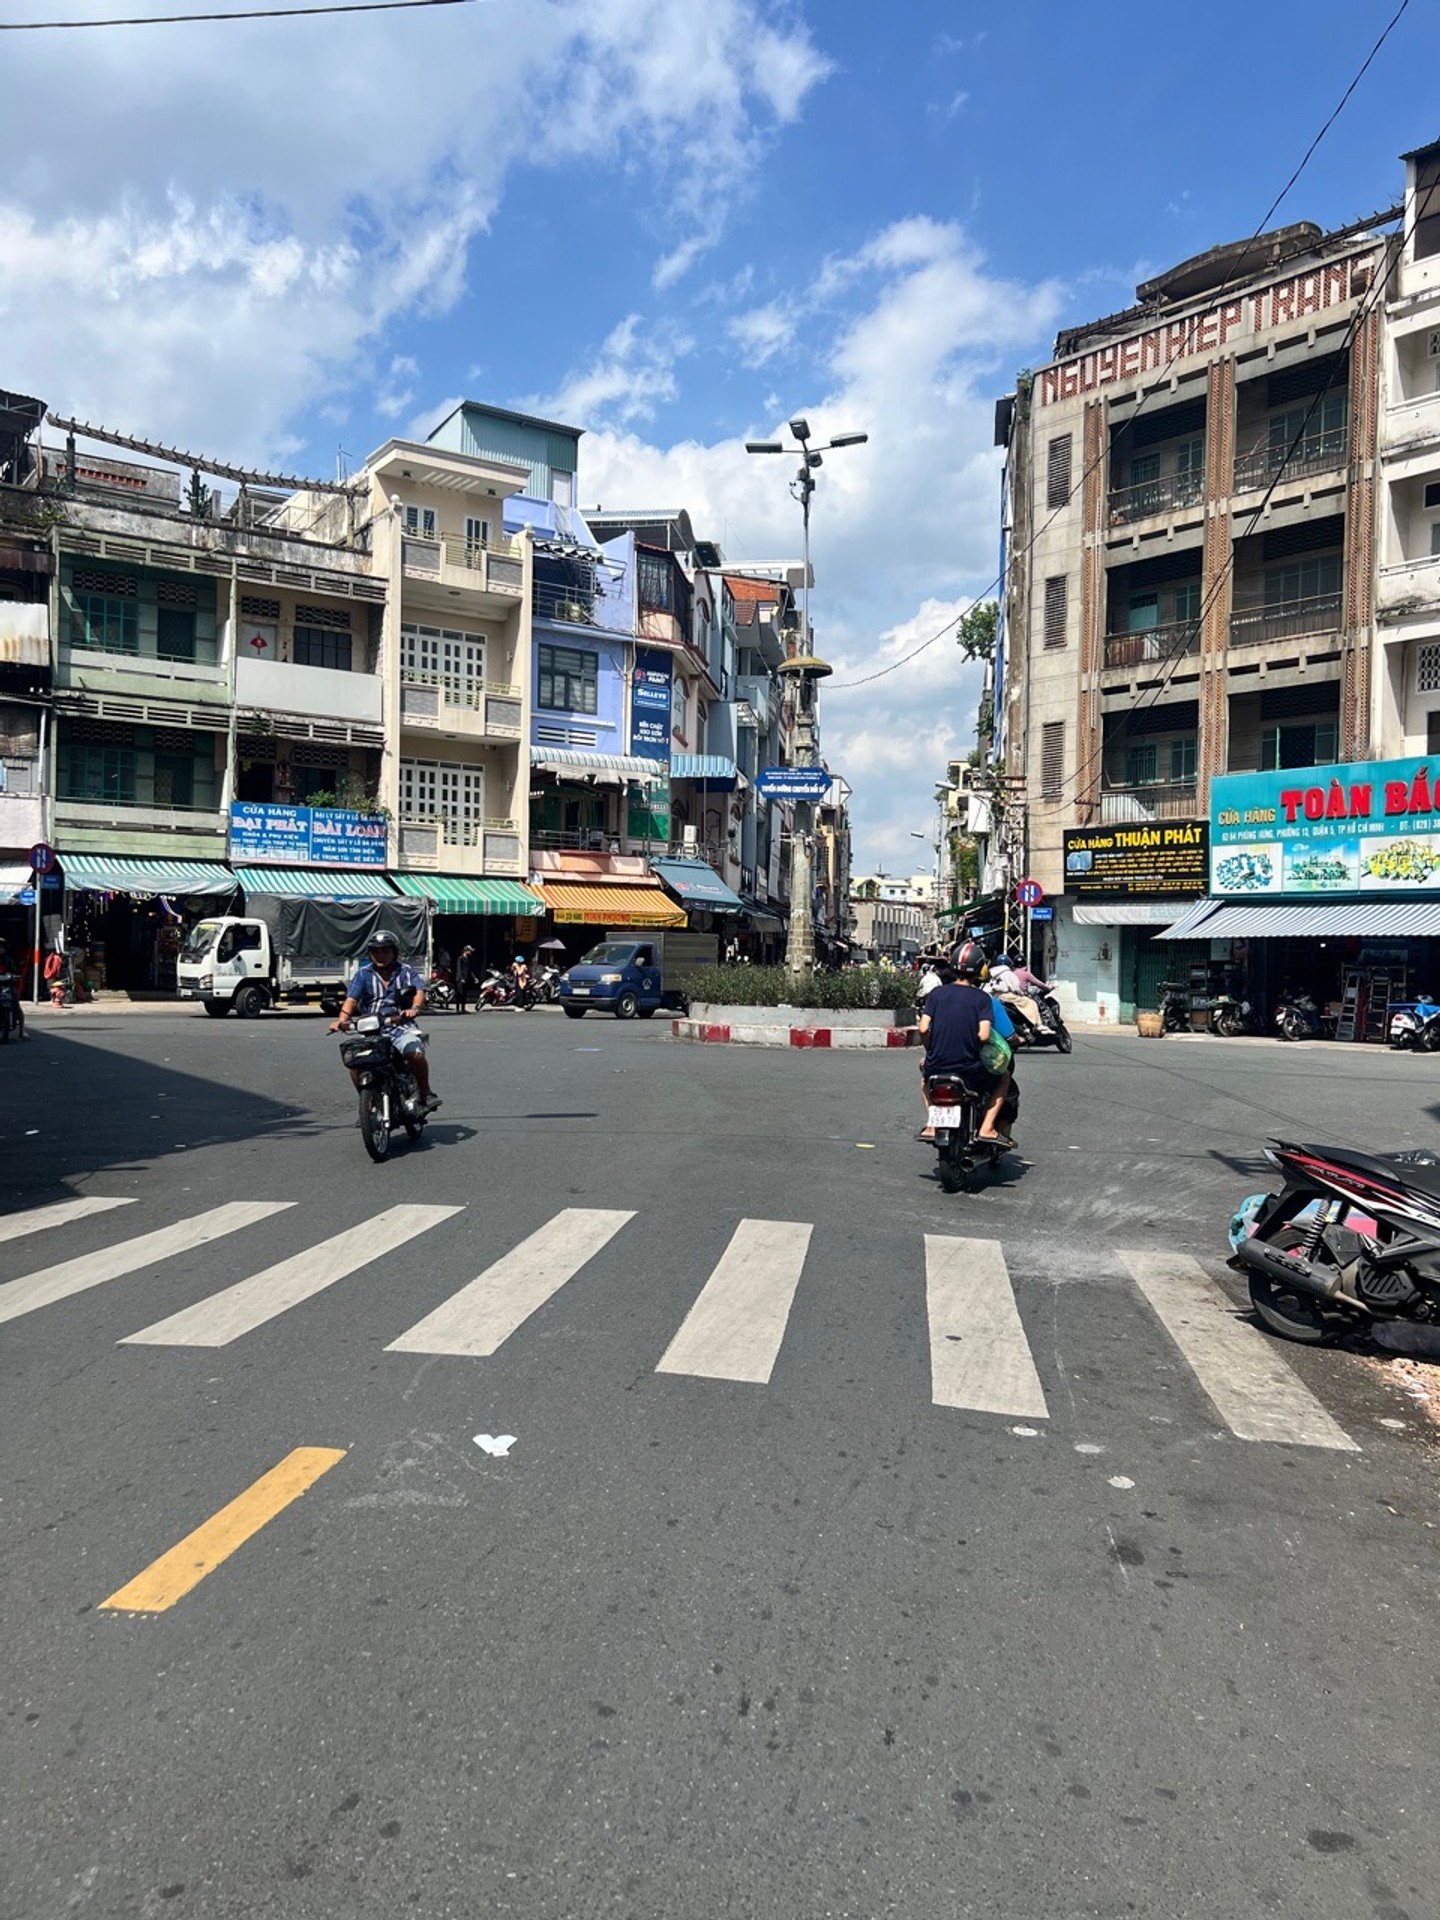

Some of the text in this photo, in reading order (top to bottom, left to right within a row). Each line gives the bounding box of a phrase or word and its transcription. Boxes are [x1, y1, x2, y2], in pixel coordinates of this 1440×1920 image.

[637, 689, 667, 699] SELLEYS
[1218, 806, 1240, 825] CỬA
[1244, 806, 1276, 824] HÀNG
[1280, 778, 1372, 822] TOÀN
[242, 804, 296, 817] CỬA HÀNG
[232, 816, 262, 830] ĐẠI
[312, 820, 386, 838] ĐÀI LOAN
[1068, 824, 1202, 850] CỬA HÀNG THUẬN PHÁT
